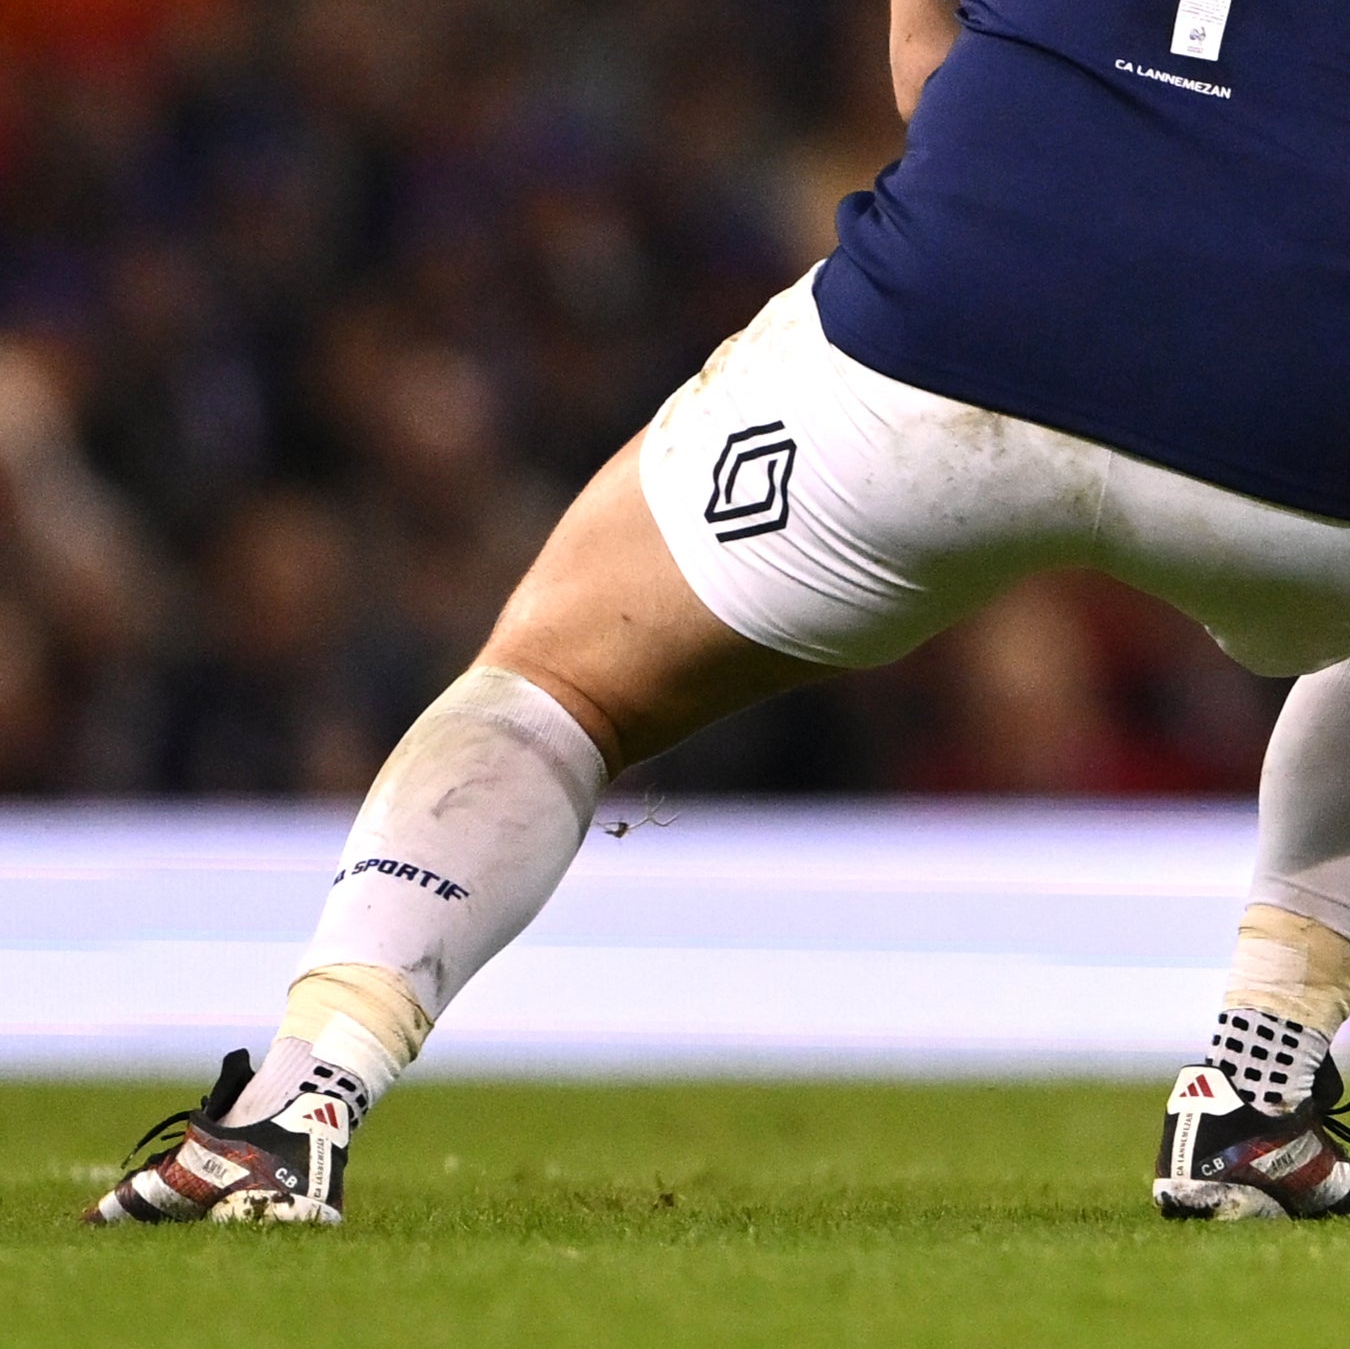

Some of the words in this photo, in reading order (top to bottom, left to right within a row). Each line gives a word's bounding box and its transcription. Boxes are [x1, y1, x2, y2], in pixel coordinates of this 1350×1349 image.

[1115, 59, 1133, 72] CA
[1137, 65, 1231, 99] LANNEMEZAN
[351, 858, 470, 902] SPORTIF
[275, 1168, 297, 1188] C.B
[1201, 1157, 1224, 1177] C.B
